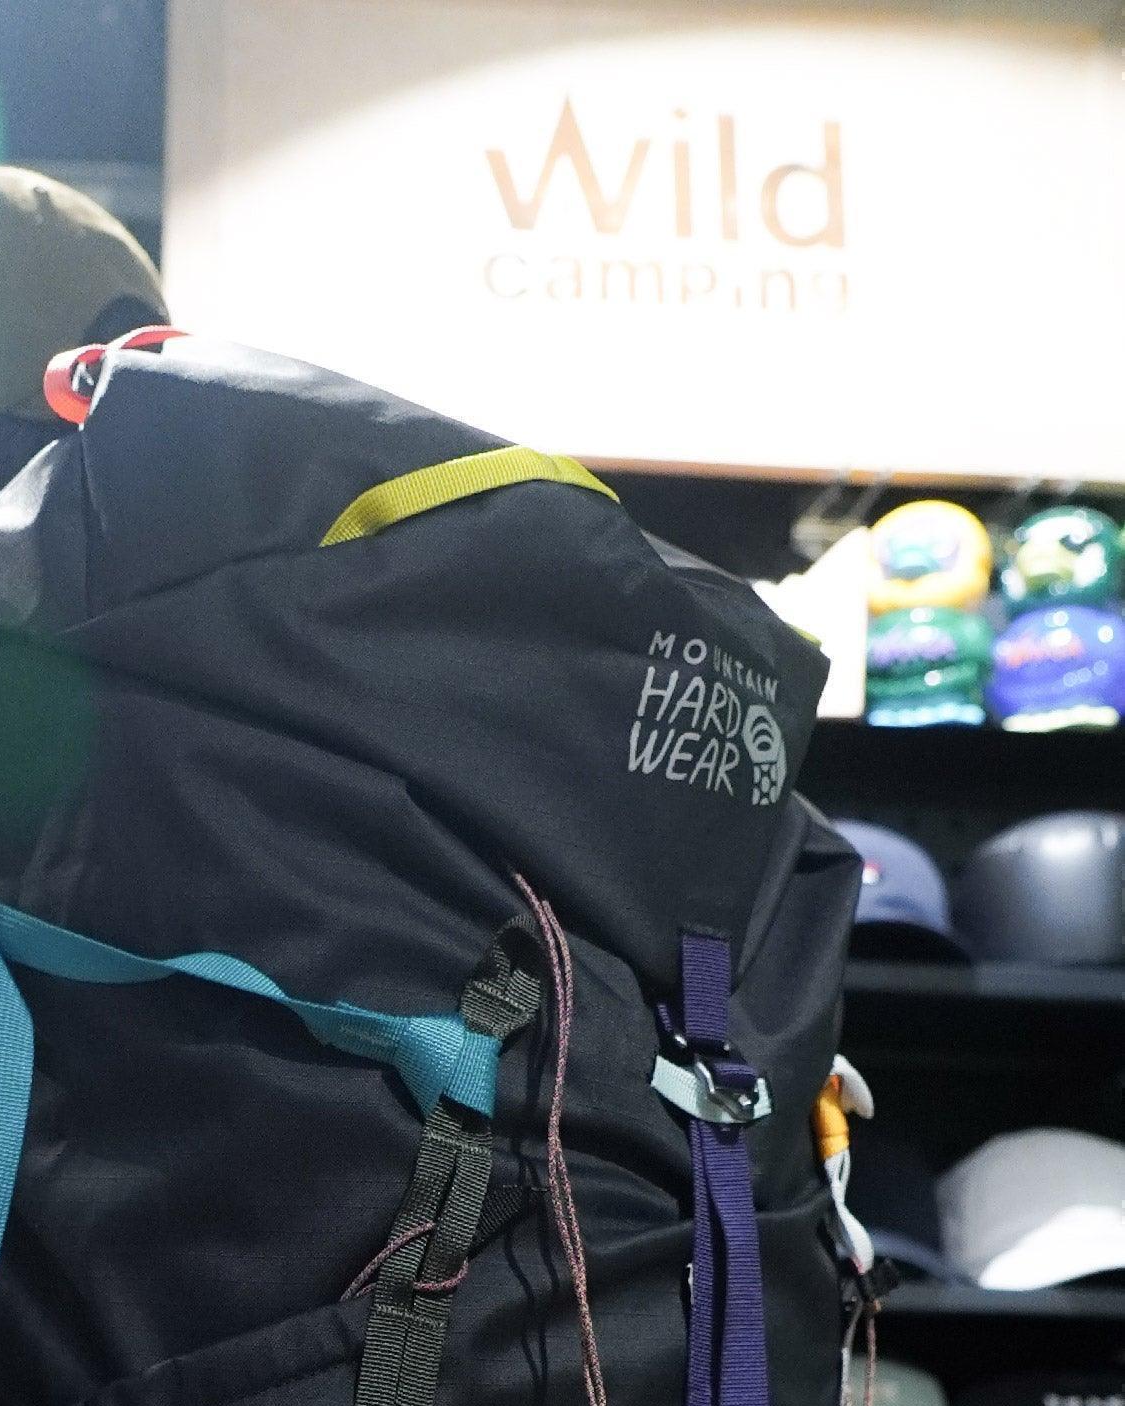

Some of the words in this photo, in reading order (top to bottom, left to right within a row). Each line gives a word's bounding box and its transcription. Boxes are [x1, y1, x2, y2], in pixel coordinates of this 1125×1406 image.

[485, 95, 846, 249] Wild
[637, 666, 742, 739] HARD
[648, 629, 778, 703] MOUNTAIN
[627, 720, 741, 796] WEAR
